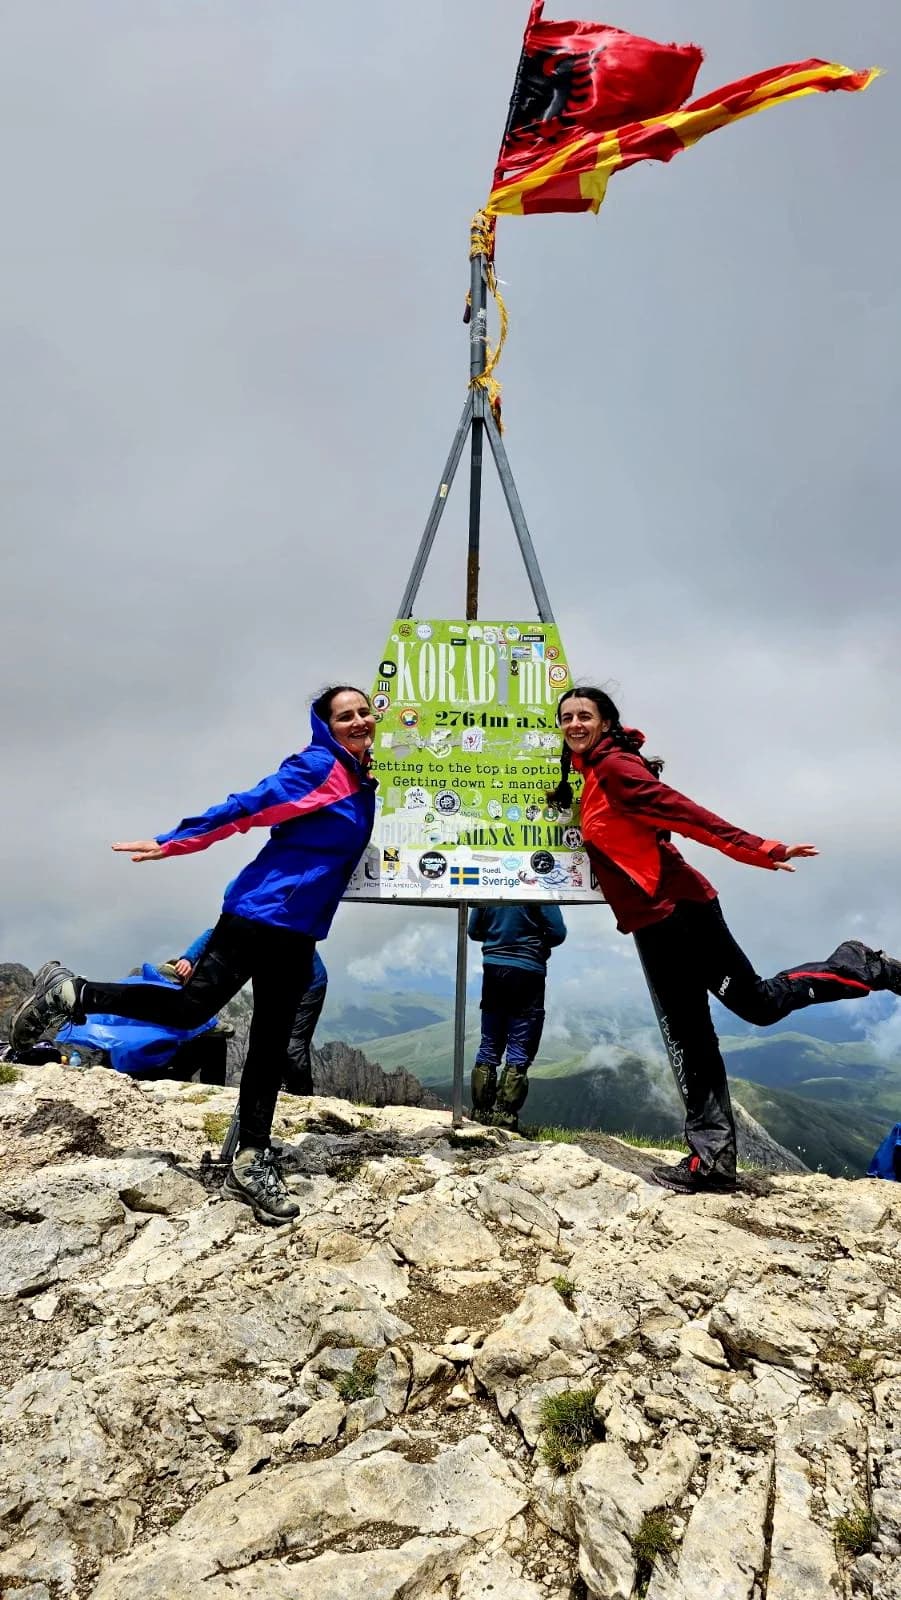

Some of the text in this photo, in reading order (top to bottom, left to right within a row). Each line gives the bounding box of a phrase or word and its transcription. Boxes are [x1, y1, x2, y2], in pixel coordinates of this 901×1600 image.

[396, 641, 496, 704] KORAB
[435, 710, 509, 728] 2764m
[370, 761, 578, 775] Getting to the top is optio
[392, 776, 447, 788] Getting
[451, 778, 485, 788] down
[508, 780, 582, 791] mandaty
[502, 794, 518, 804] Ed
[442, 825, 498, 846] AILS
[503, 825, 515, 846] &
[520, 825, 580, 847] TRAD
[482, 875, 520, 888] Sverige
